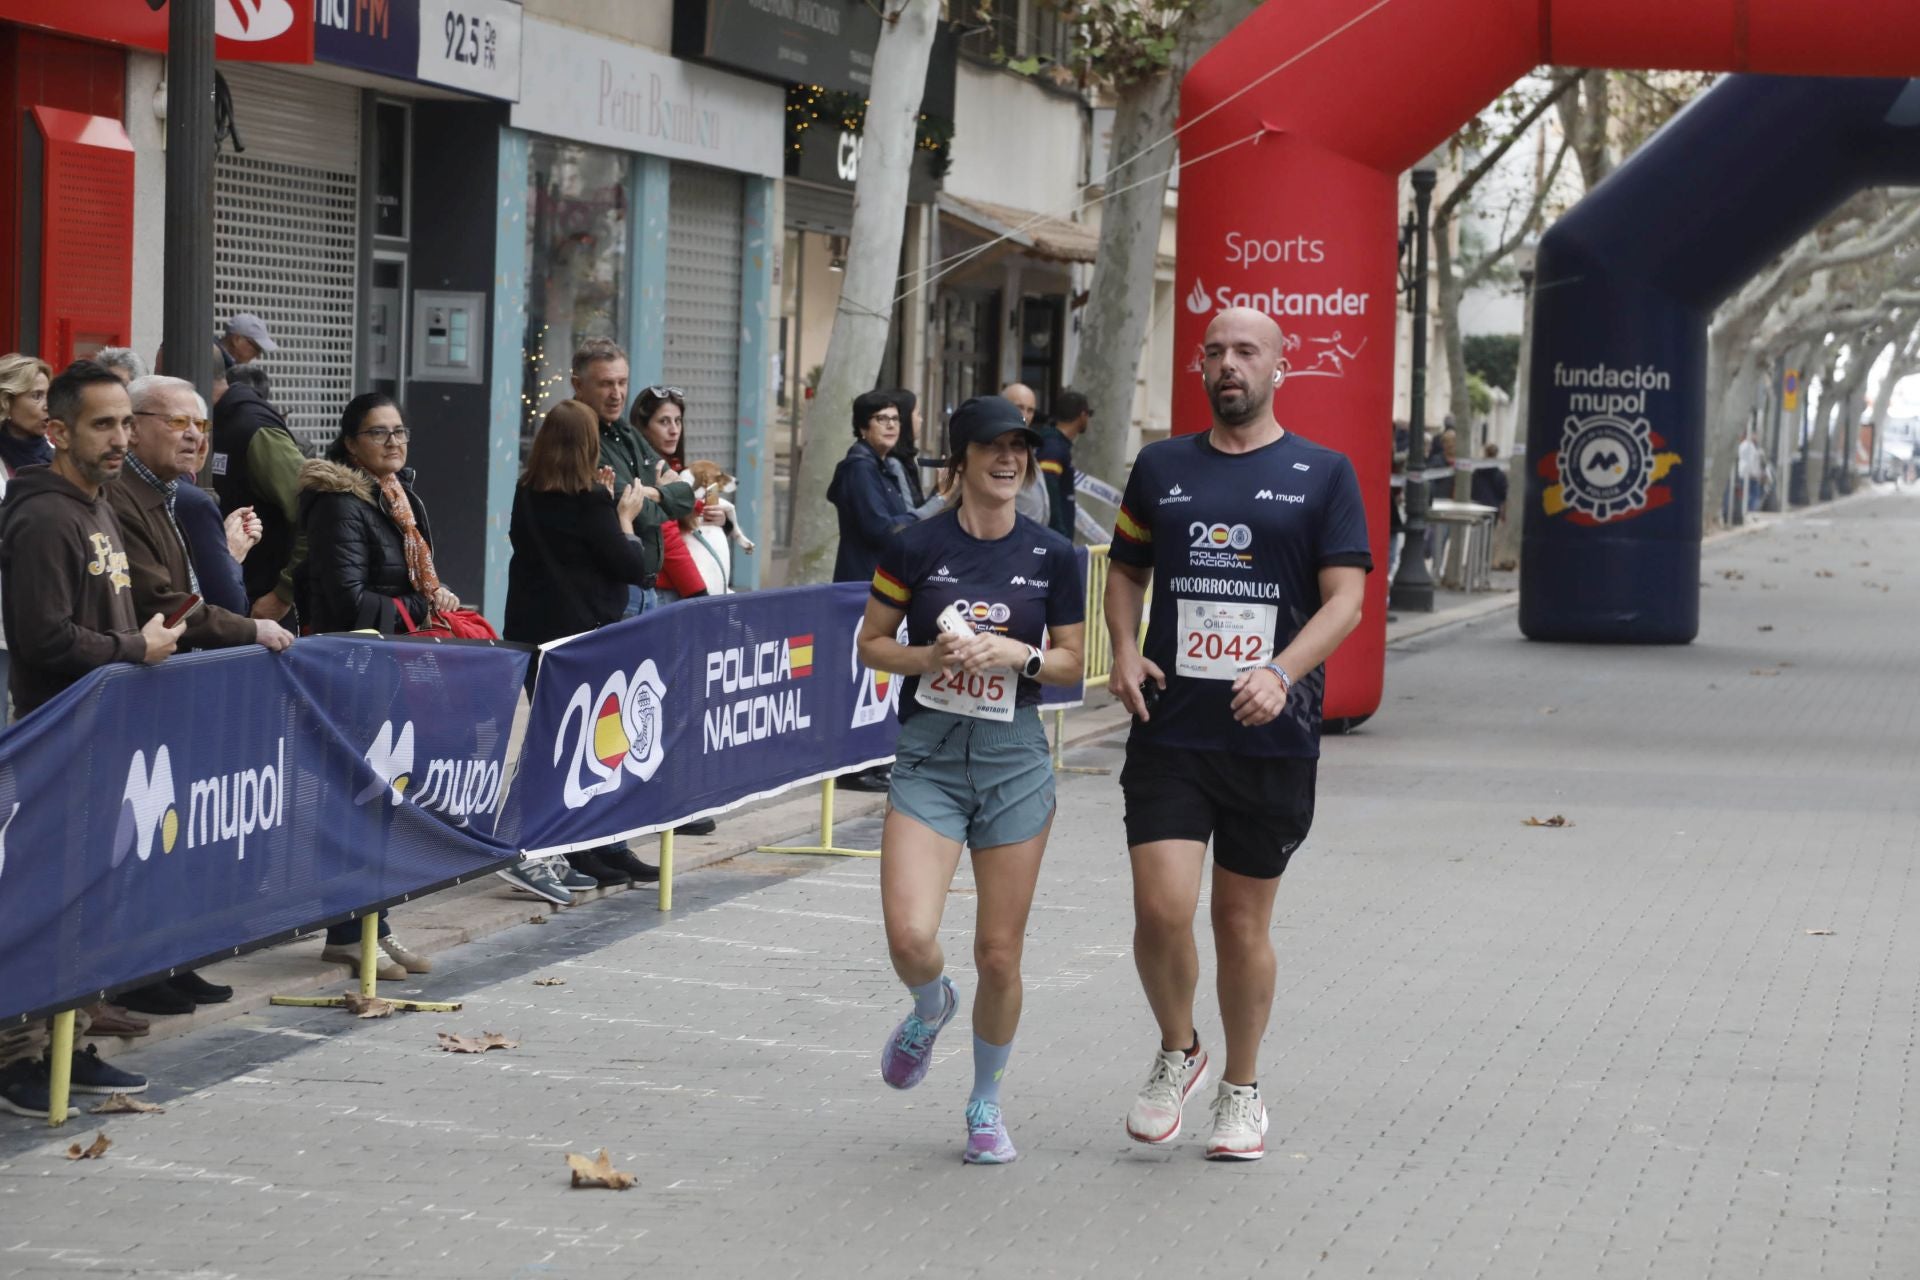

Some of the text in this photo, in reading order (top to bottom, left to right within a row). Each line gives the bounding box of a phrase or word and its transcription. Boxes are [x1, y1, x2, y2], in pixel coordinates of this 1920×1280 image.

[445, 10, 480, 66] 92.5
[597, 57, 641, 134] Petit
[1225, 231, 1325, 269] Sports
[1215, 286, 1370, 316] Santander
[1554, 362, 1671, 391] fundación
[1569, 389, 1646, 418] mupol
[1159, 495, 1193, 505] Santander
[1275, 493, 1305, 504] mupol
[1189, 521, 1253, 550] 200
[1189, 558, 1253, 569] NACIONAL
[1027, 577, 1049, 588] mupol
[1170, 576, 1281, 599] #YOCORROCONLUCA
[1187, 631, 1263, 661] 2042
[930, 669, 1005, 701] 2405
[553, 657, 668, 810] 200
[703, 687, 811, 755] NACIONAL
[187, 736, 285, 860] mupol
[411, 758, 502, 827] mupol
